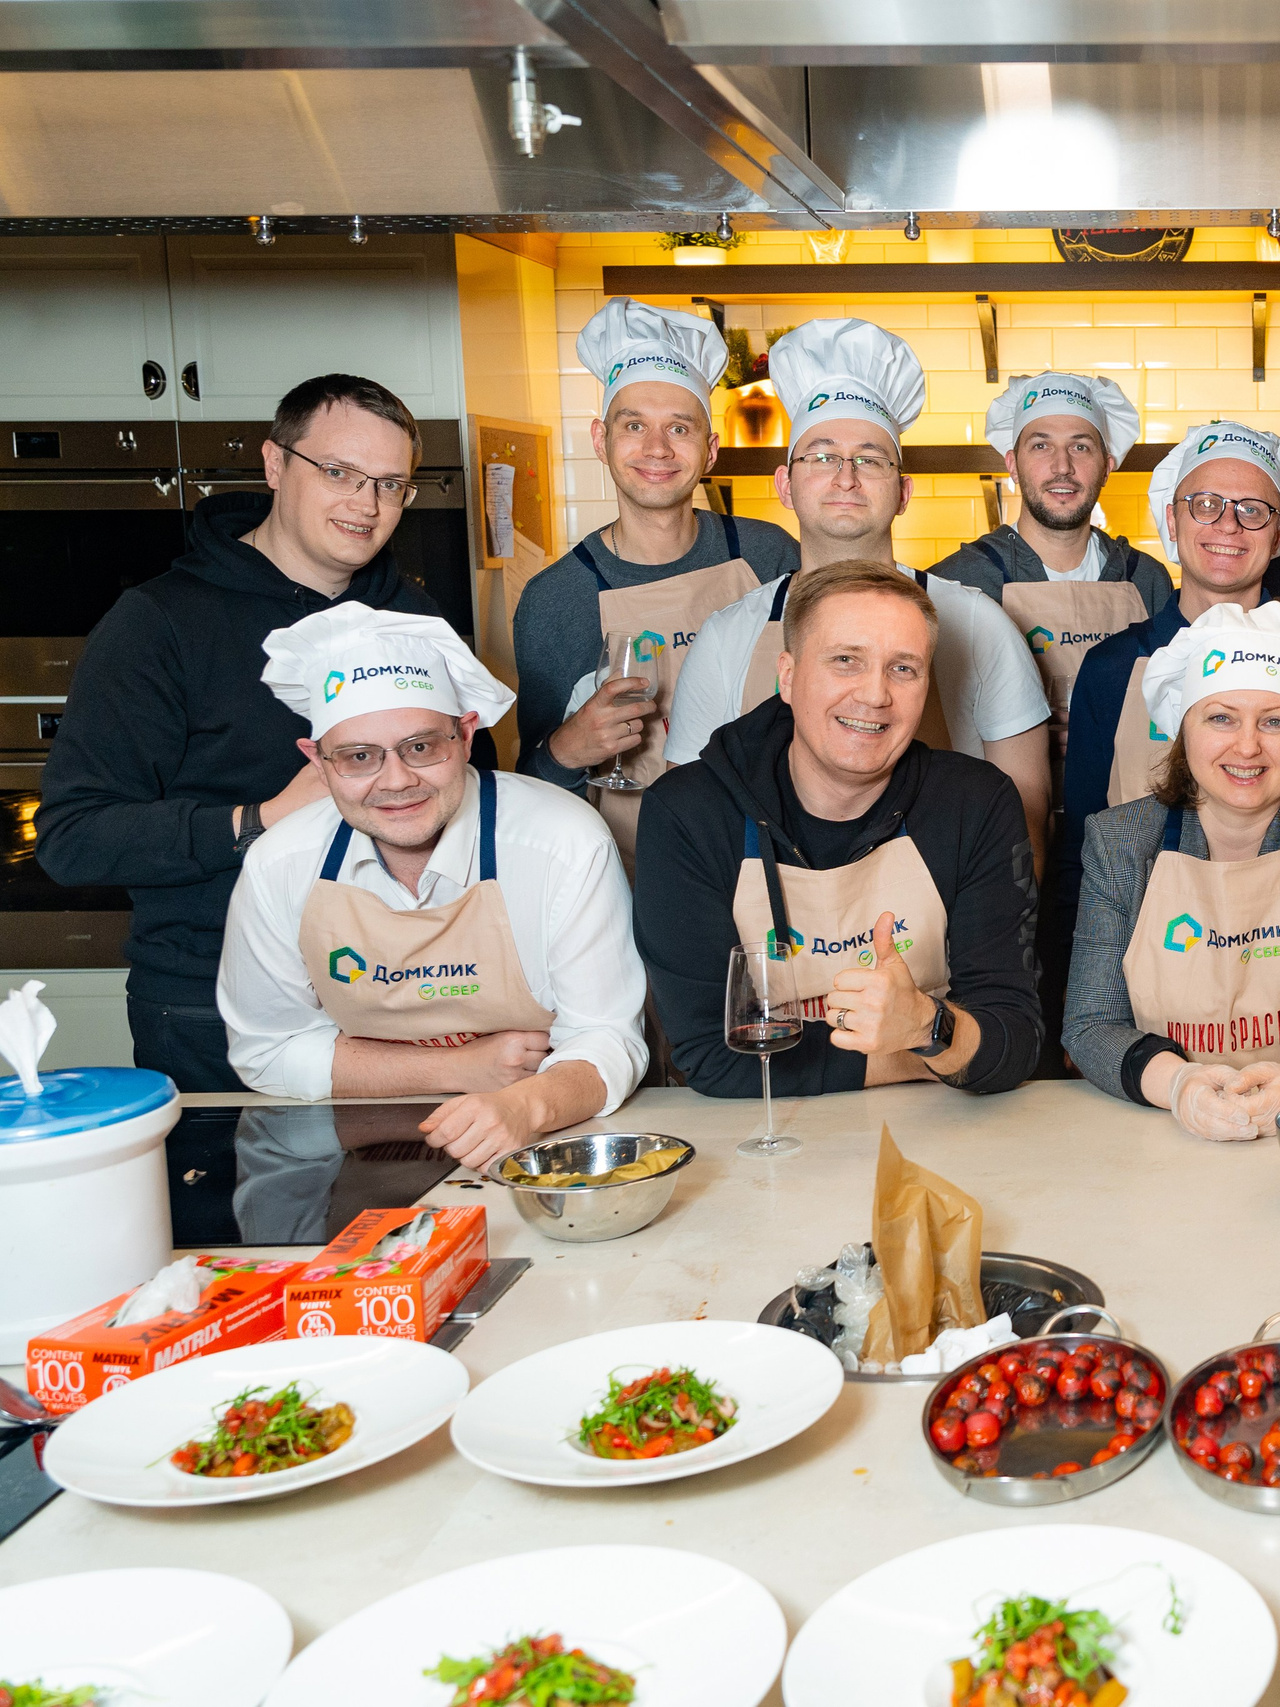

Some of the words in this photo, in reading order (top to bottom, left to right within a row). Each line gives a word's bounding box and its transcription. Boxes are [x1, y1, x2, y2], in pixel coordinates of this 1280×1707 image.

[627, 356, 687, 371] Домклик
[1041, 388, 1092, 405] Домклик
[1222, 433, 1277, 463] Домклик
[352, 665, 431, 684] Домклик
[411, 680, 434, 690] СБЕР
[372, 963, 479, 985] Домклик
[440, 984, 480, 996] СБЕР
[326, 1210, 391, 1254] MATRIX
[289, 1289, 343, 1301] MATRIX
[354, 1284, 413, 1298] CONTENT
[300, 1301, 332, 1310] VINYL
[354, 1294, 415, 1327] 100
[307, 1316, 325, 1329] XL
[357, 1323, 417, 1336] GLOVES
[154, 1318, 223, 1372] MATRIX
[31, 1348, 84, 1361] CONTENT
[92, 1352, 142, 1366] MATRIX
[31, 1359, 85, 1393] 100
[102, 1364, 132, 1375] VINYL
[35, 1389, 88, 1404] GLOVES
